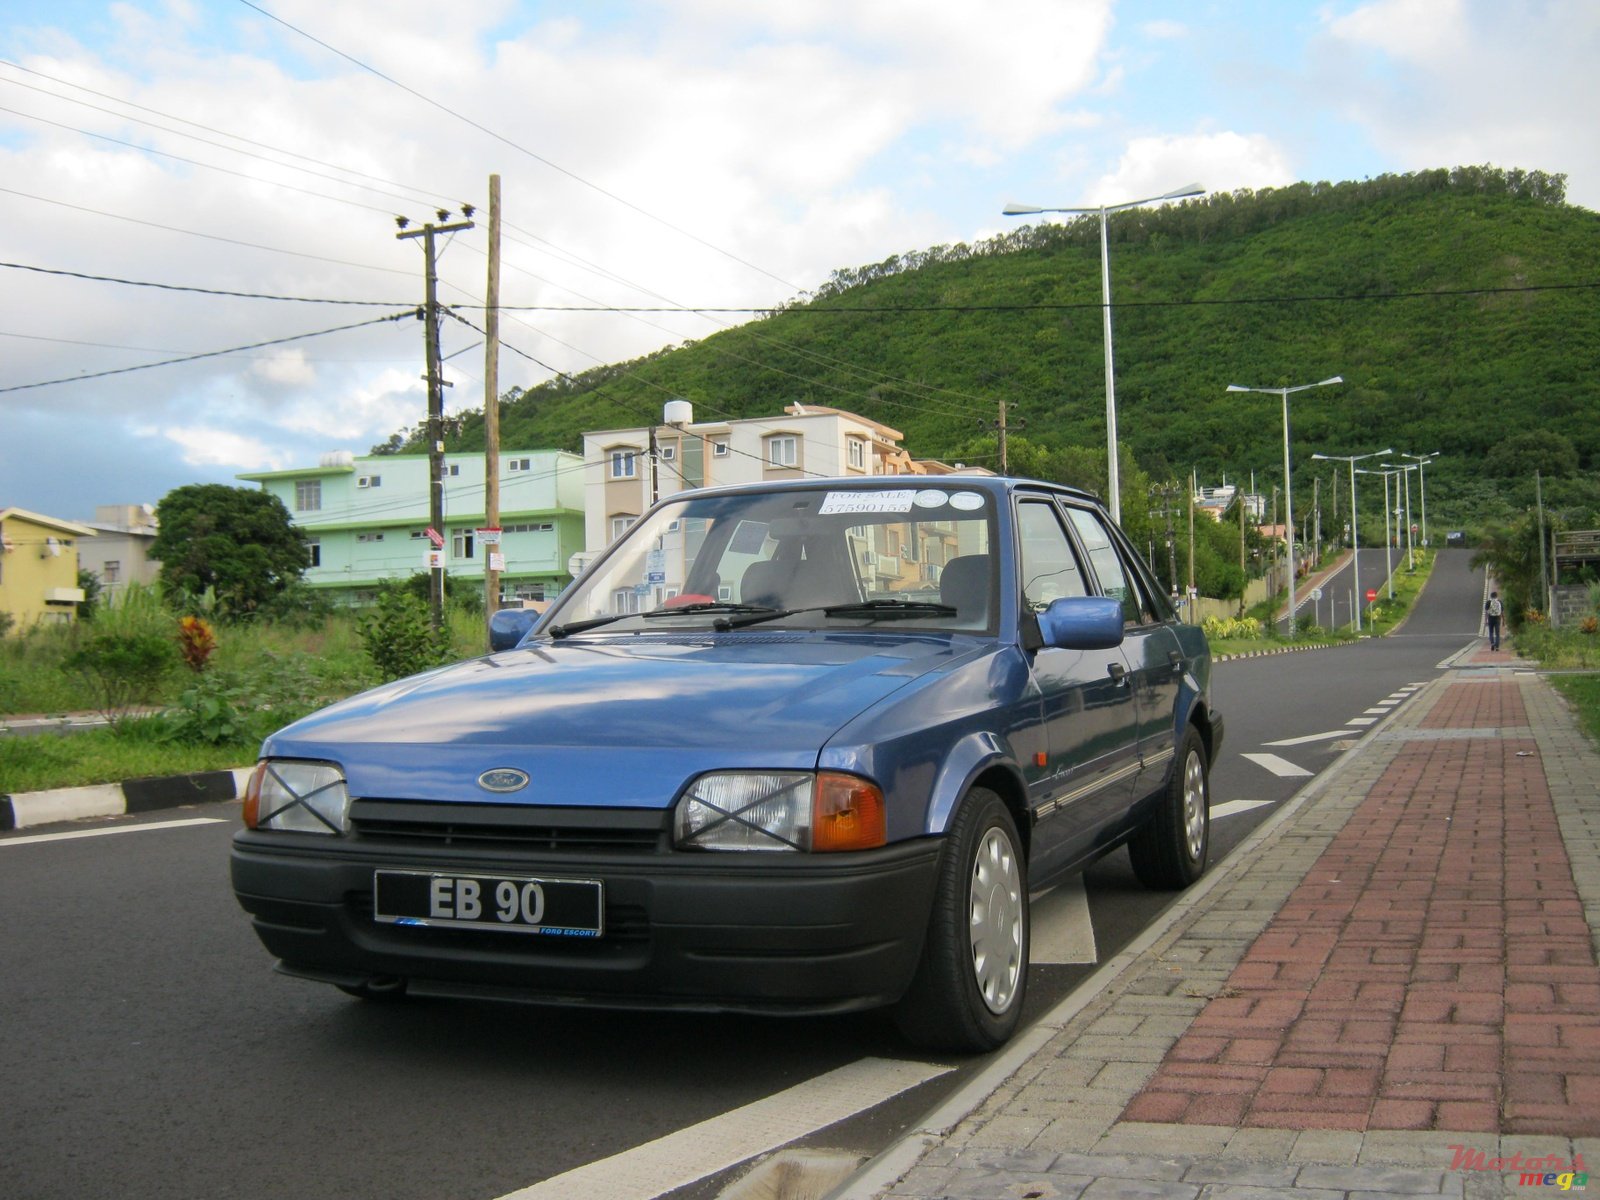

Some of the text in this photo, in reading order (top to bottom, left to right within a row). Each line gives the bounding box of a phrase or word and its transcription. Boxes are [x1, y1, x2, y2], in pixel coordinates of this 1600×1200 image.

[831, 492, 863, 500] FOR
[865, 490, 908, 499] SALE
[430, 878, 545, 924] EB 90
[540, 927, 596, 937] FORD ESCORT
